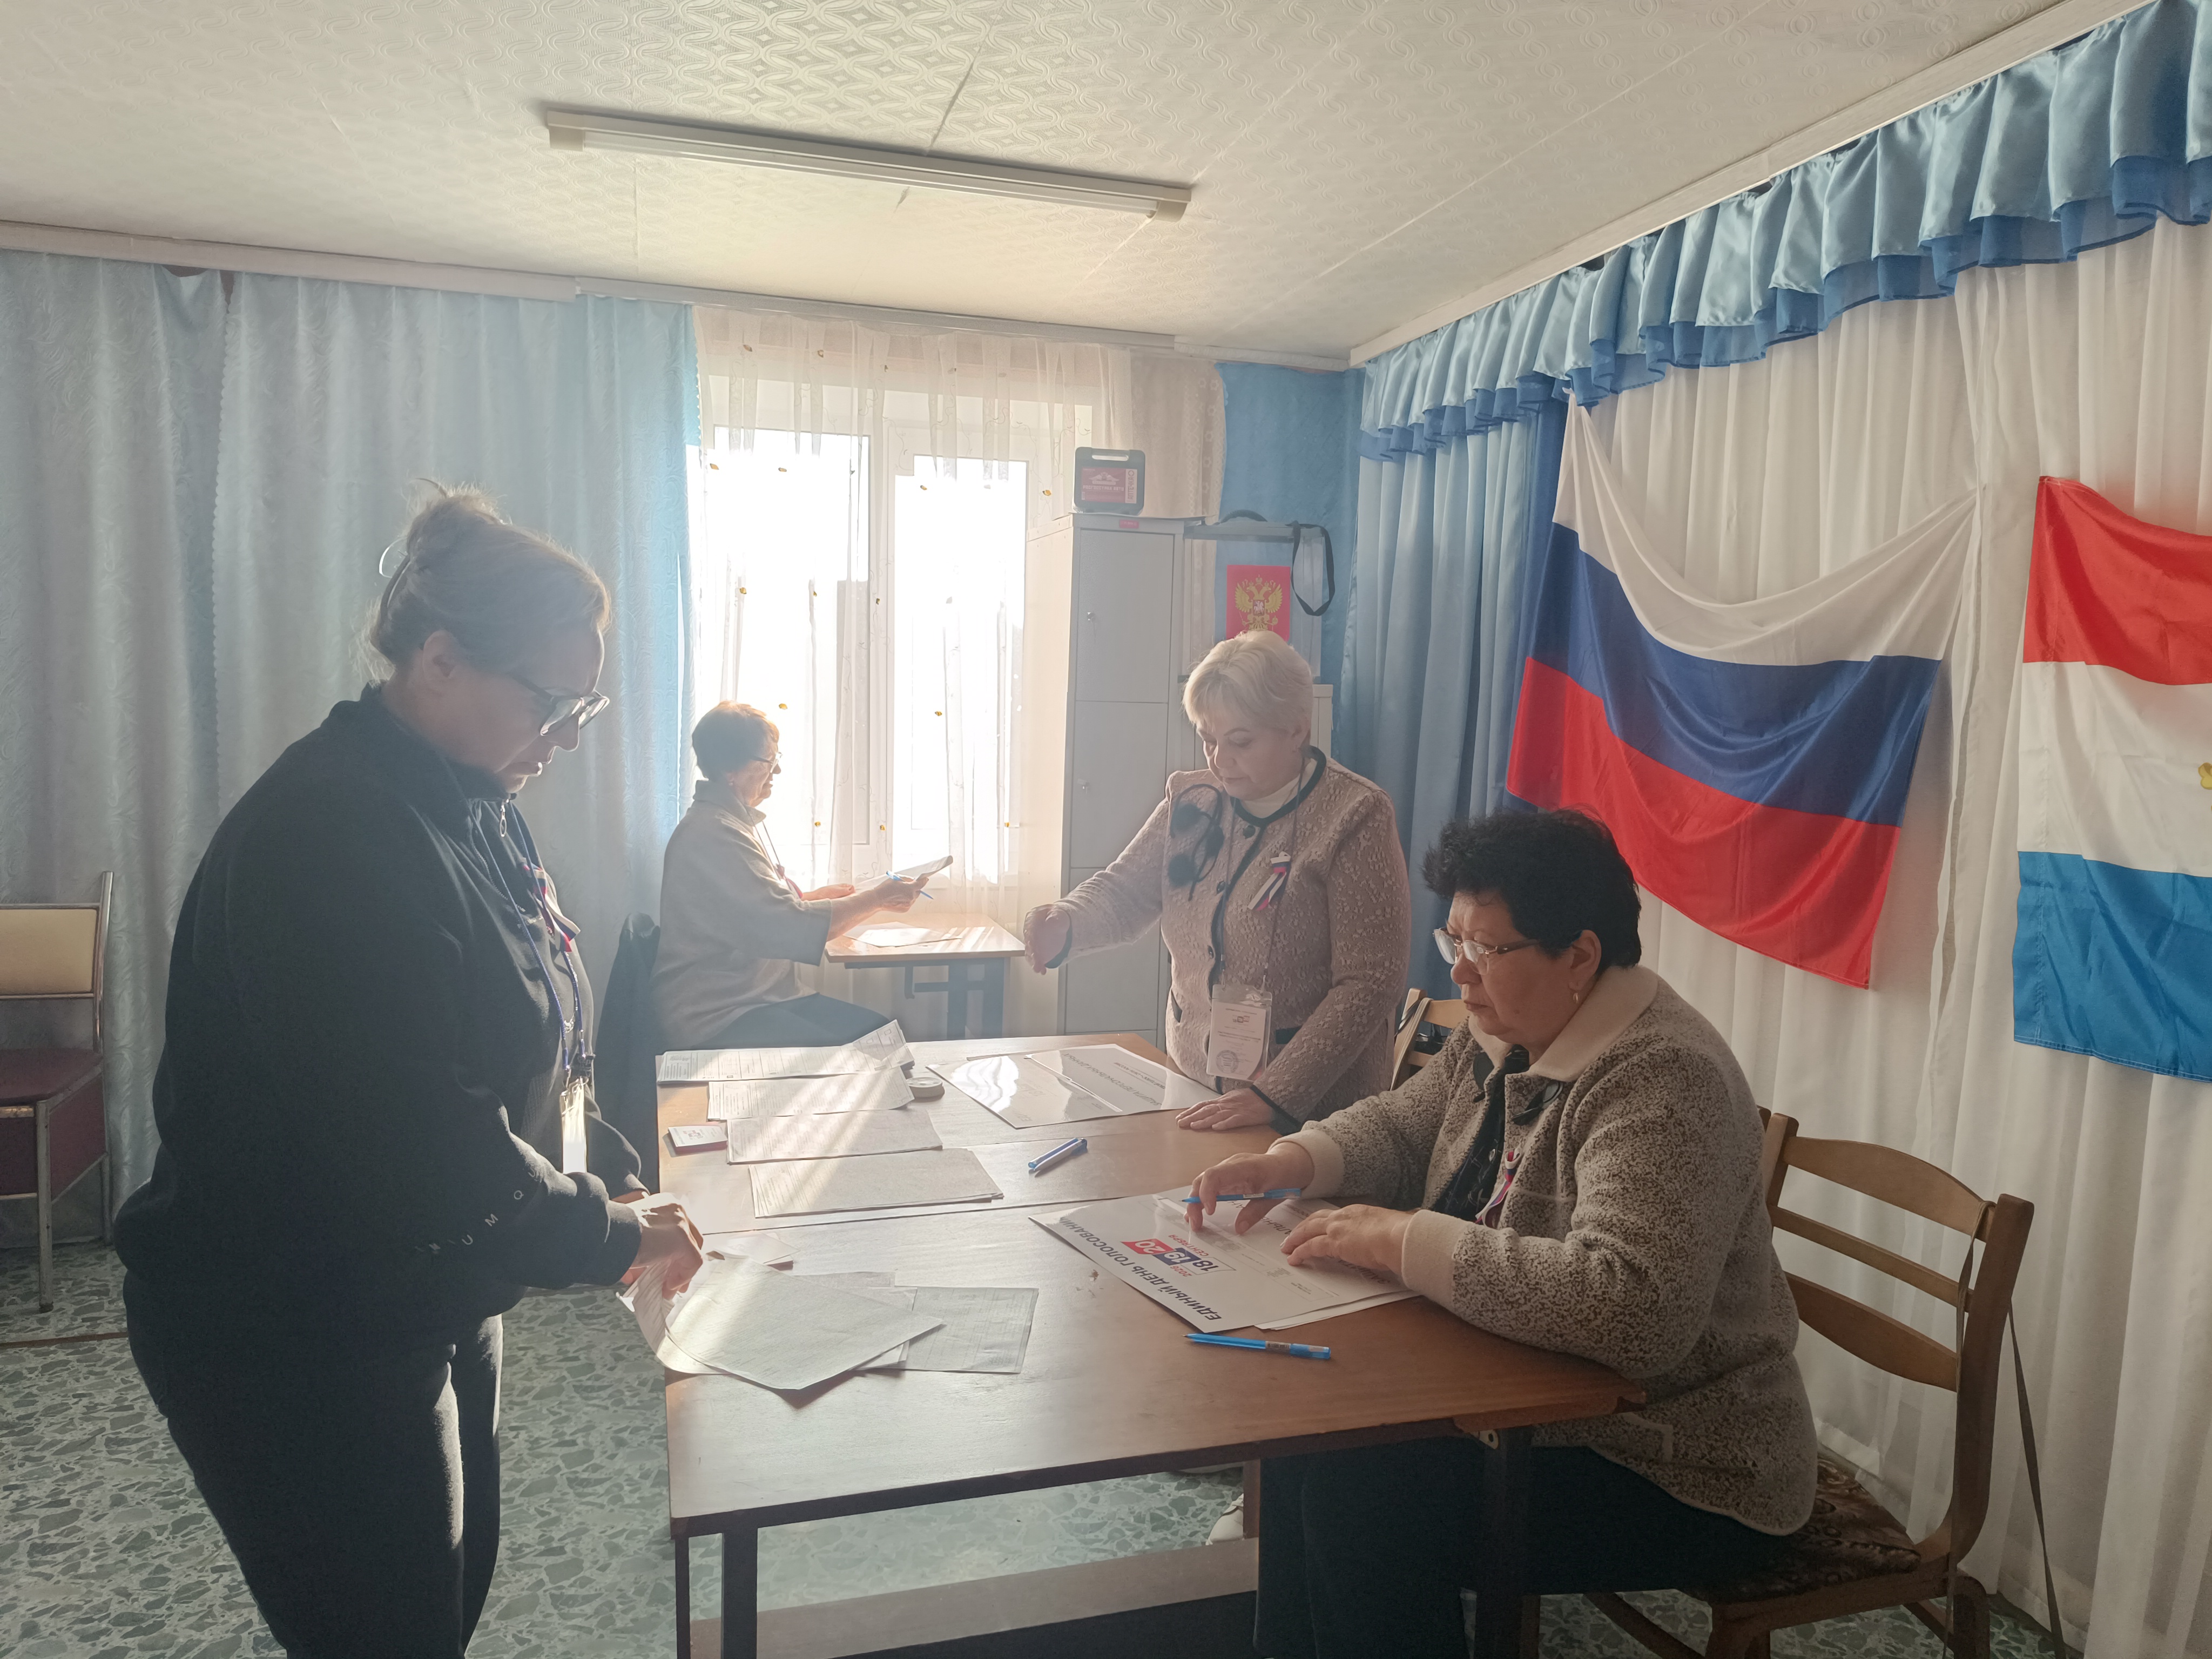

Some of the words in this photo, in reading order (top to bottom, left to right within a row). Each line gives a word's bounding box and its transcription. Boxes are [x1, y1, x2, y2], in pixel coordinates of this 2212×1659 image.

[1135, 1241, 1166, 1254] 20
[1168, 1234, 1209, 1257] СЕНТЯБРЯ
[1164, 1251, 1191, 1263] 19
[1170, 1265, 1192, 1277] 2026
[1192, 1260, 1219, 1271] 18
[1131, 1266, 1170, 1285] ДЕНЬ
[1157, 1285, 1222, 1320] ЕДИНЫЙ
